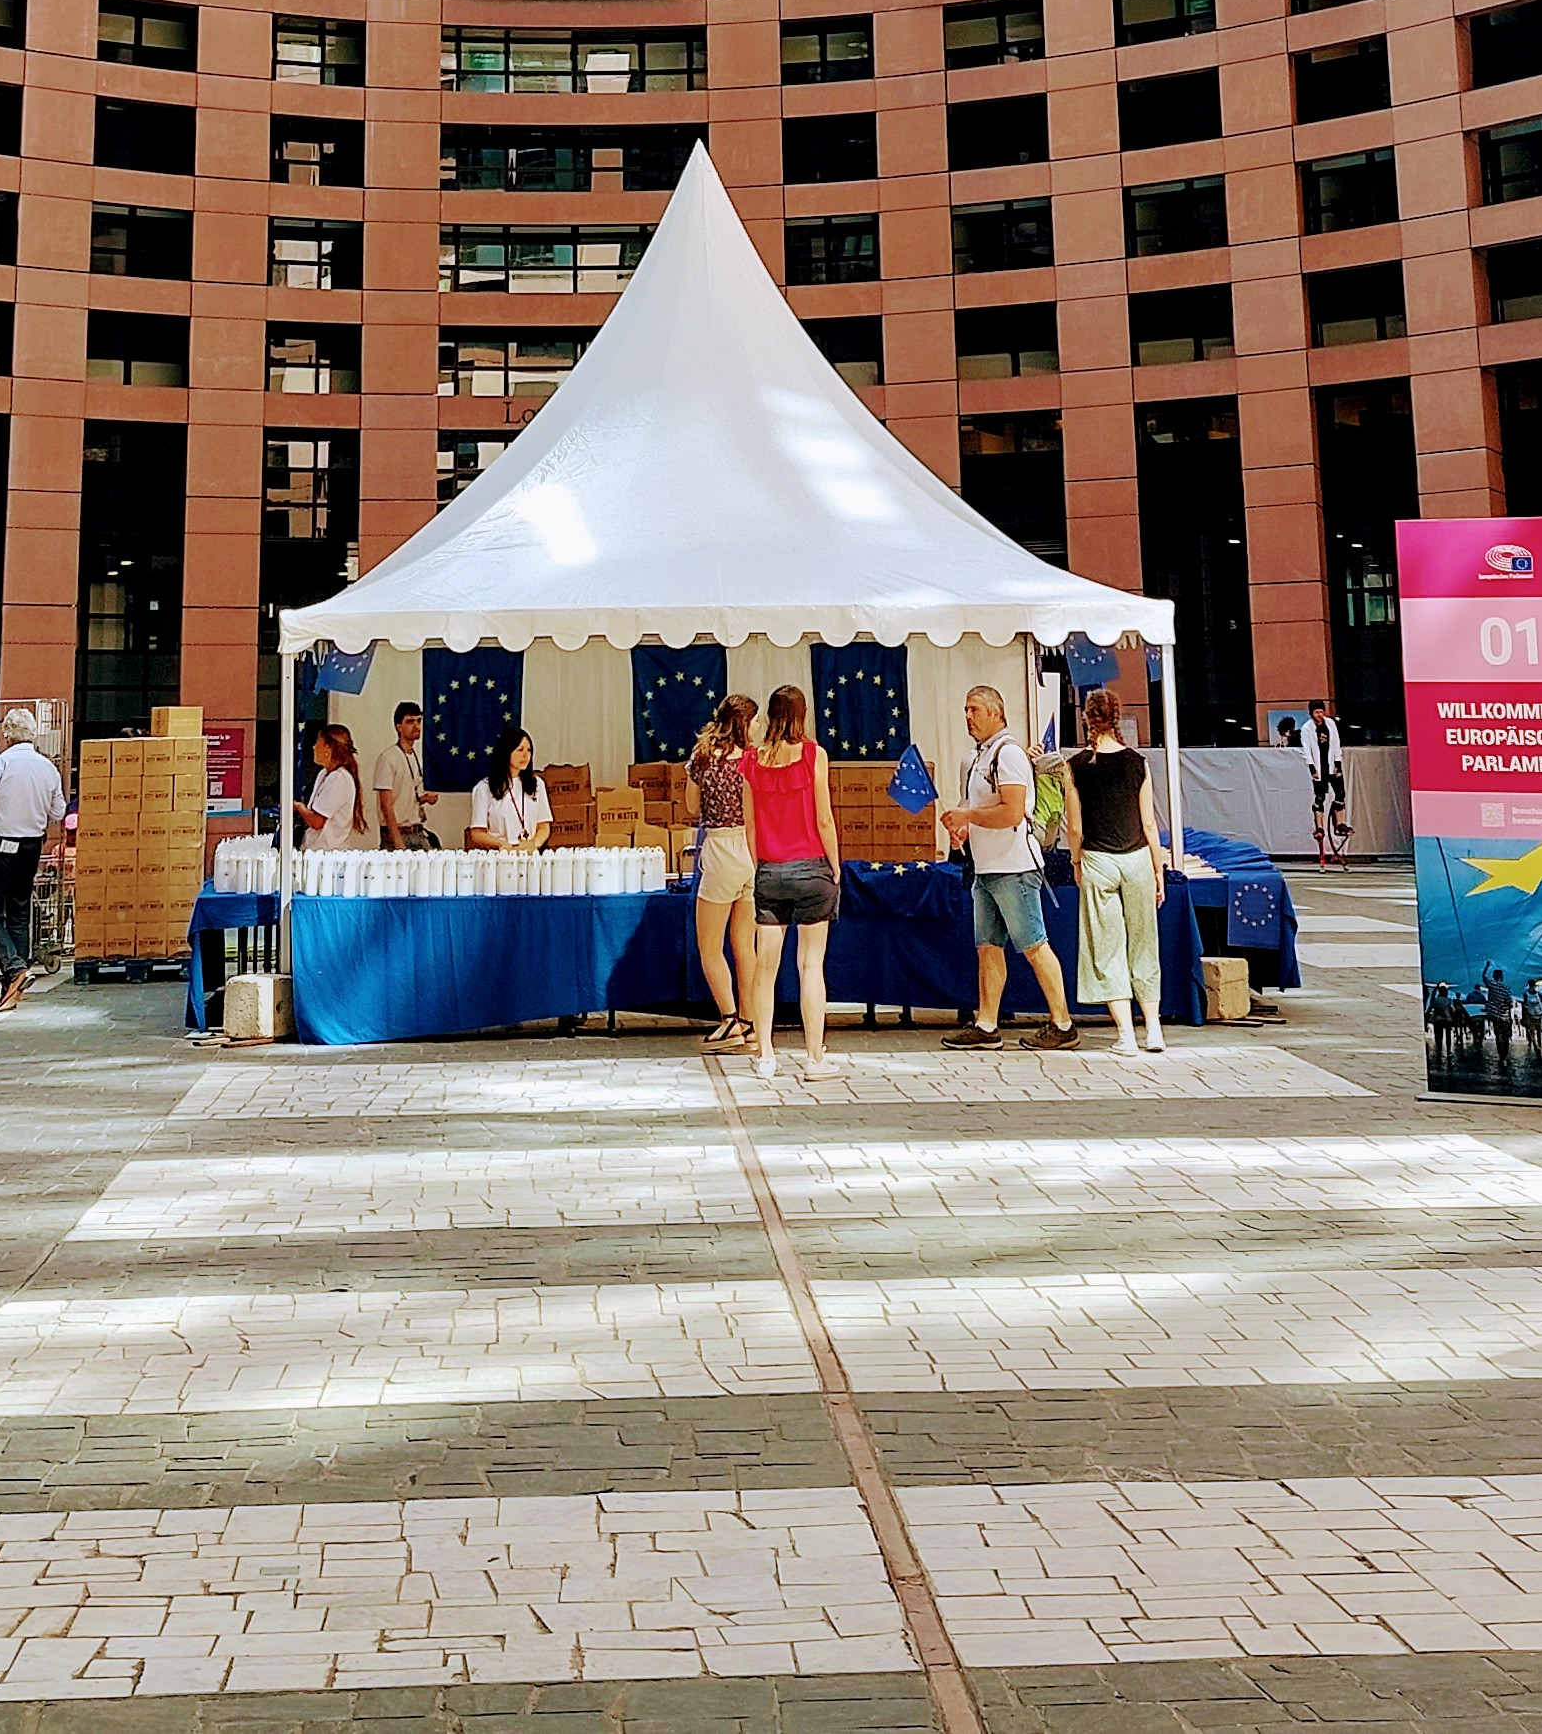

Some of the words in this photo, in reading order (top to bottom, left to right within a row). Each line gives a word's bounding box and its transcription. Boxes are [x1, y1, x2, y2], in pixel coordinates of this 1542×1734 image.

[1479, 616, 1539, 666] 01
[601, 812, 615, 821] CITY
[617, 812, 639, 820] WATER
